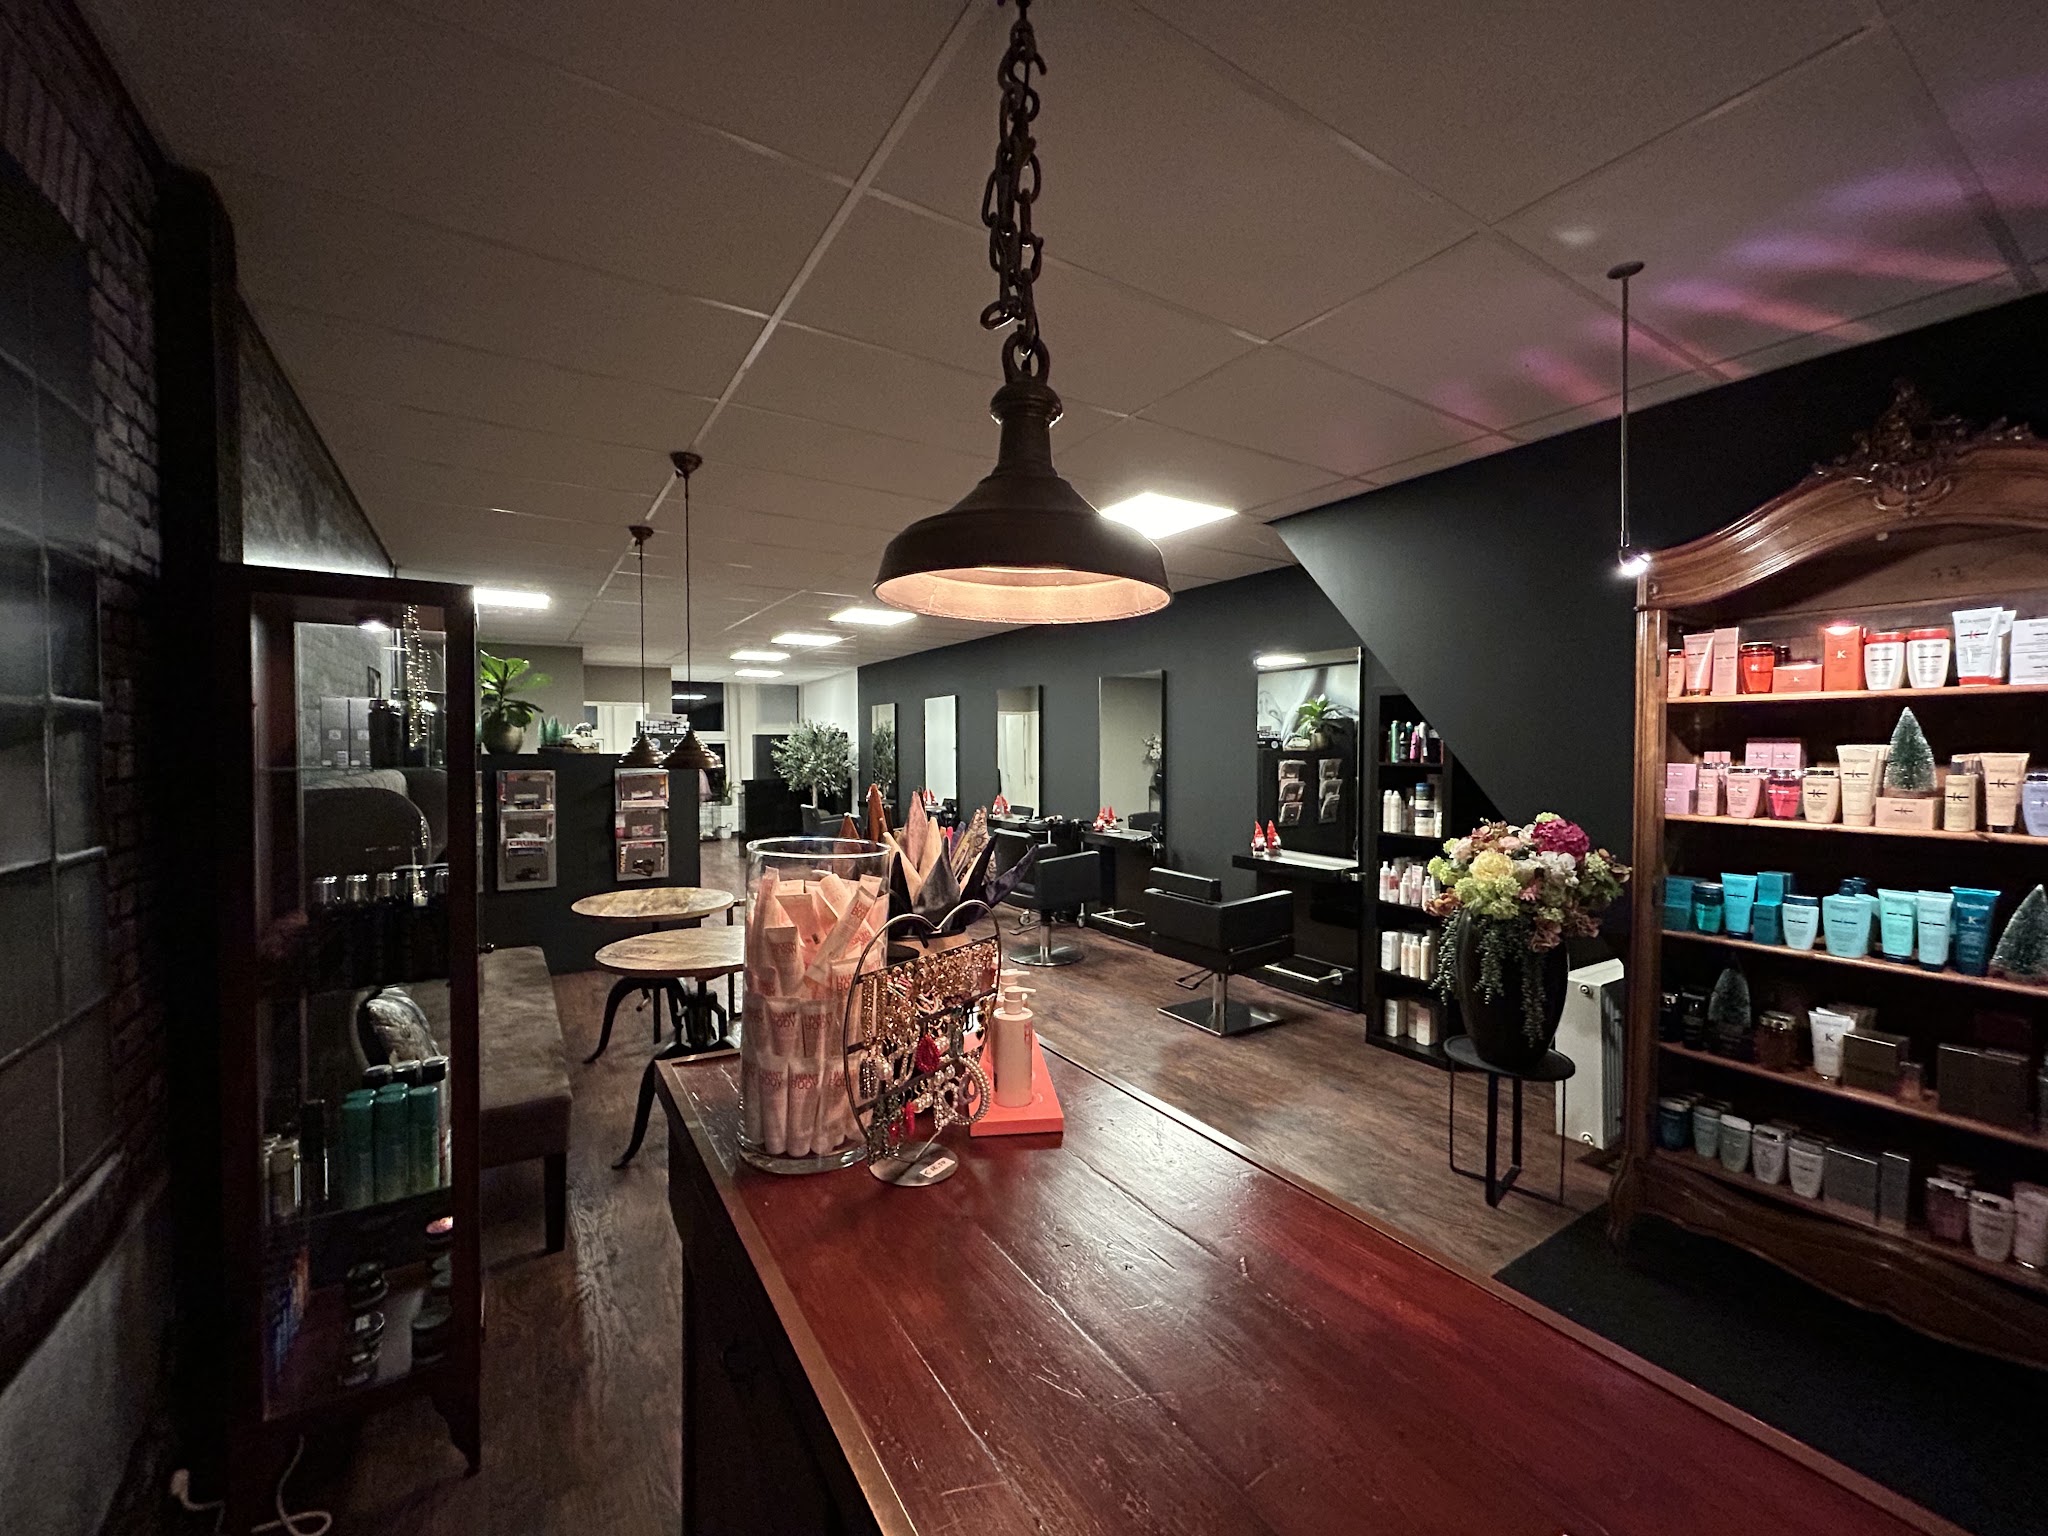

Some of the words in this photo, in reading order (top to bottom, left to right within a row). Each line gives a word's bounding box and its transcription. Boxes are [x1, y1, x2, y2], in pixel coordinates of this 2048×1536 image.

[1836, 650, 1847, 659] K
[1968, 916, 1977, 925] K
[1825, 1033, 1834, 1043] K
